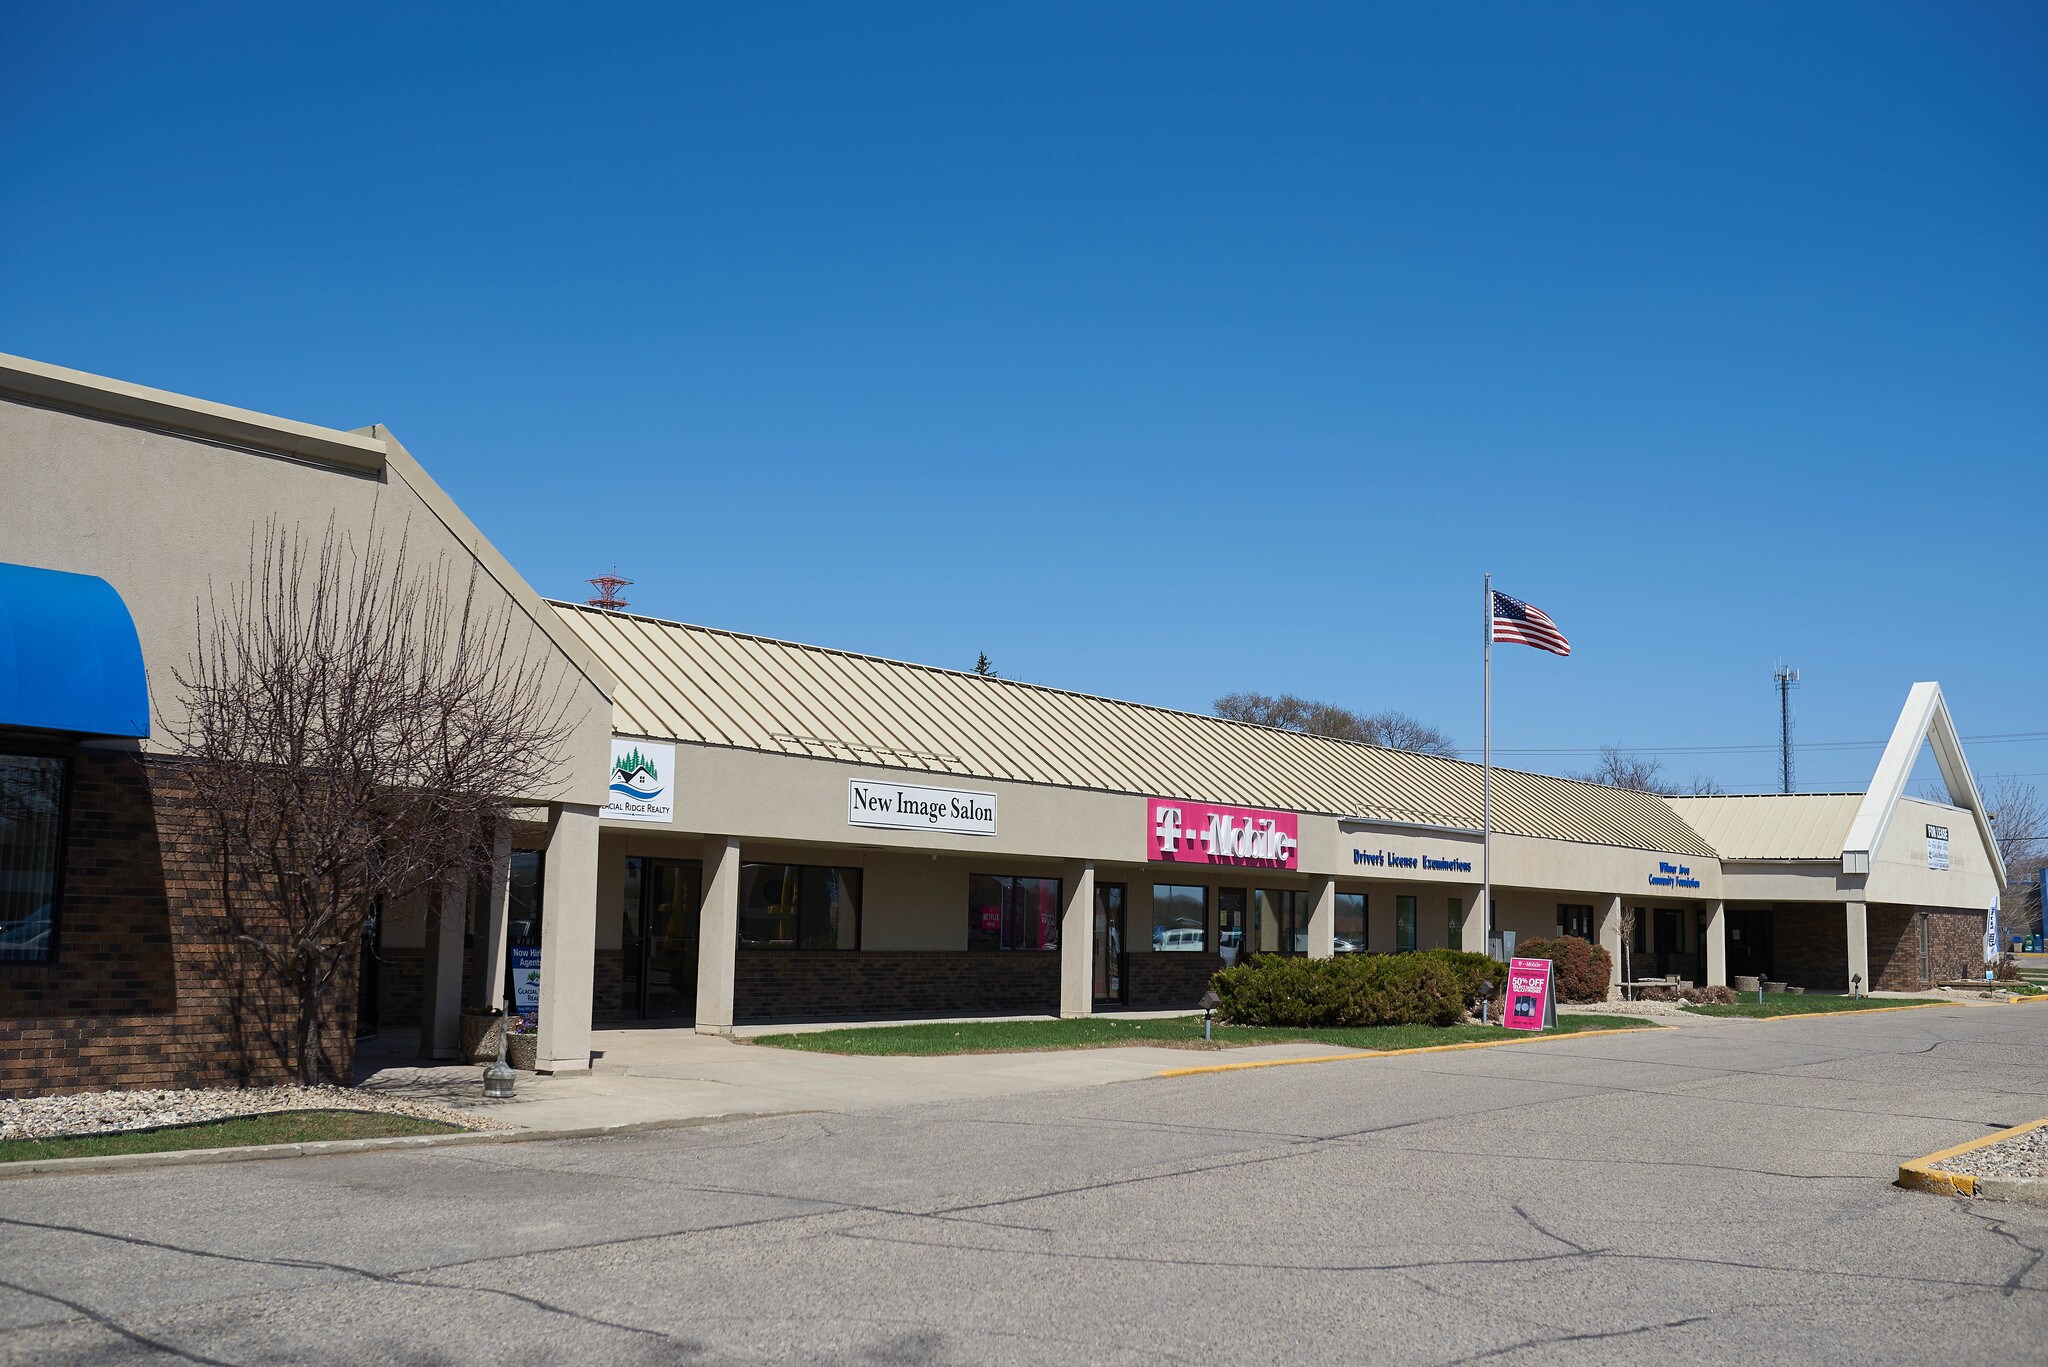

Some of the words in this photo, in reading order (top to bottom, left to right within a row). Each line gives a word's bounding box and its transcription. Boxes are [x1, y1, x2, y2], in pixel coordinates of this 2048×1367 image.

[647, 804, 671, 814] REALTY
[853, 787, 892, 812] New
[896, 791, 947, 823] Image
[950, 797, 993, 822] Salon
[1353, 848, 1385, 867] Driver's
[1387, 851, 1418, 869] License
[1422, 855, 1472, 873] Examinations
[982, 913, 1000, 921] NETFLIX
[513, 948, 529, 957] Now
[1512, 977, 1528, 986] 50%
[1529, 978, 1545, 987] OFF
